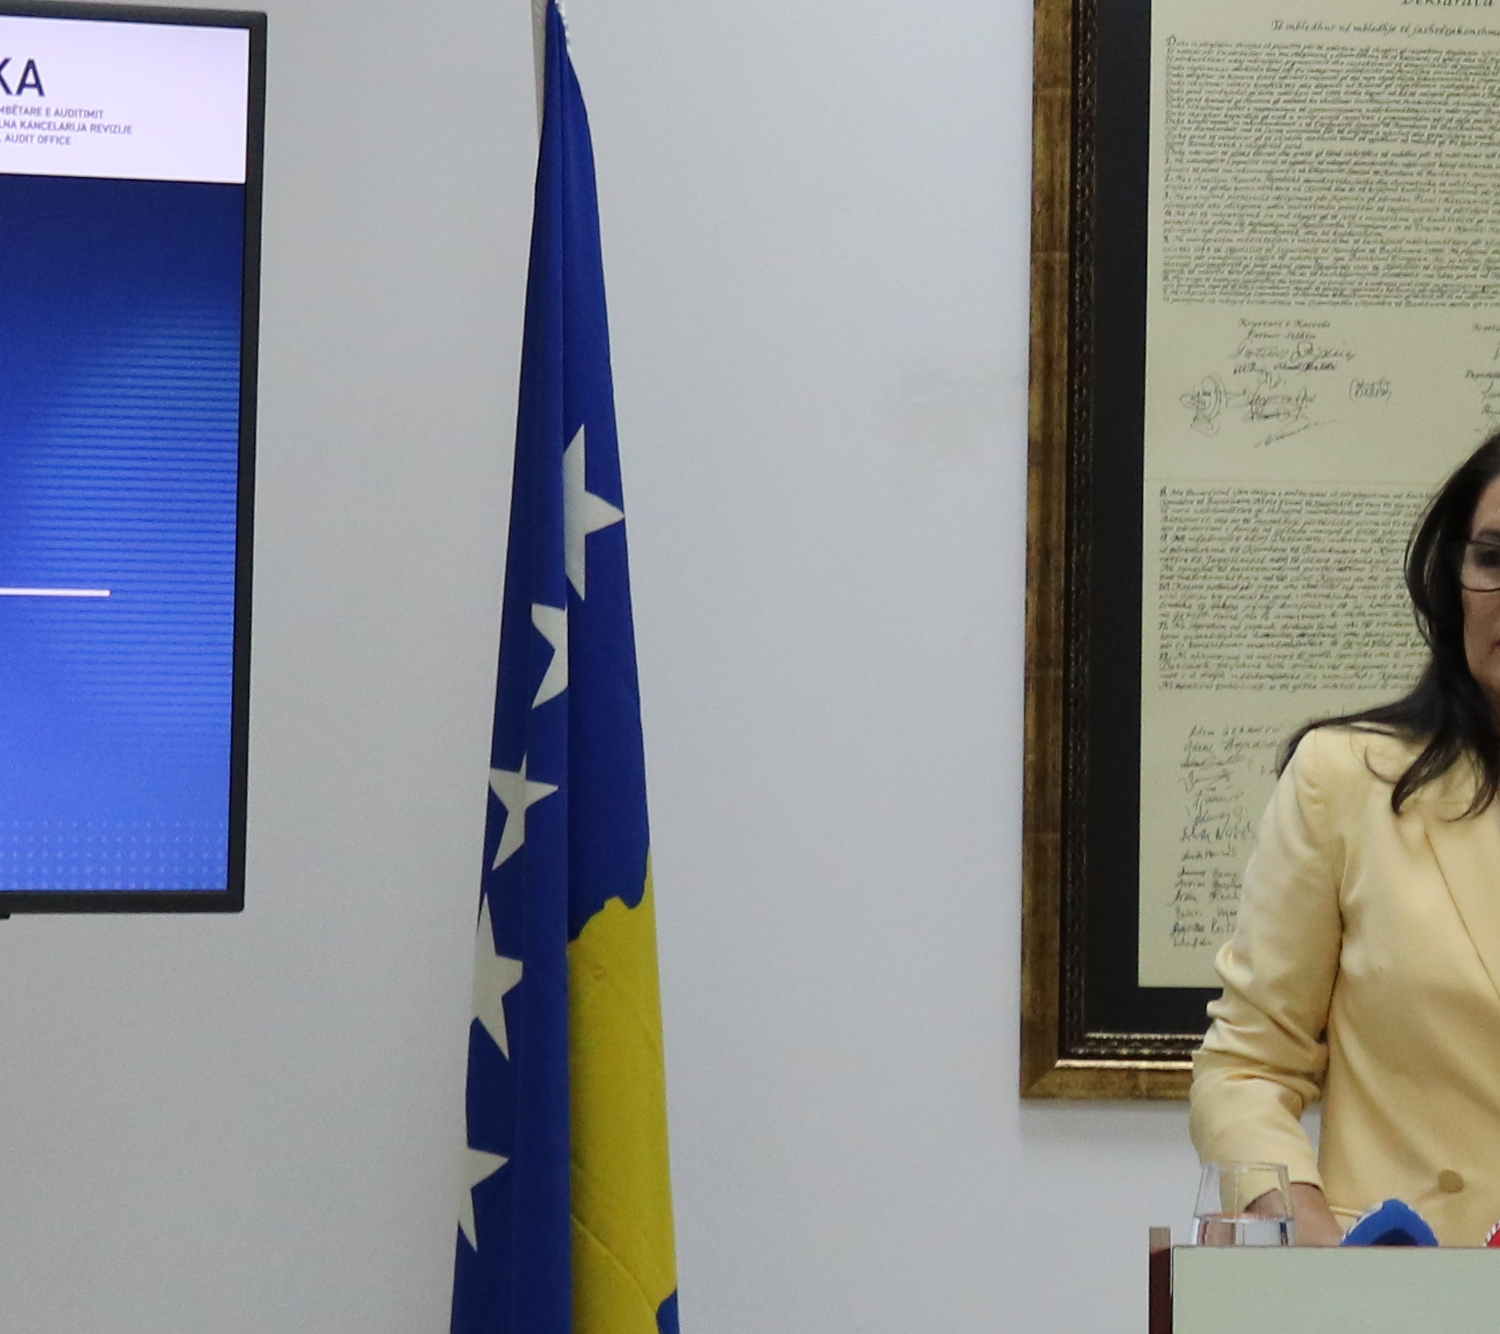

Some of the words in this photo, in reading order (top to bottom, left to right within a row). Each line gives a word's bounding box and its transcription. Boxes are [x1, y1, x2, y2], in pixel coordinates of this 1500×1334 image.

[44, 106, 51, 117] E
[53, 107, 105, 119] AUDITIMIT
[19, 120, 88, 133] KANCELARIJA
[89, 123, 133, 135] REVIZIJE
[4, 133, 34, 145] AUDIT
[37, 135, 71, 146] OFFICE
